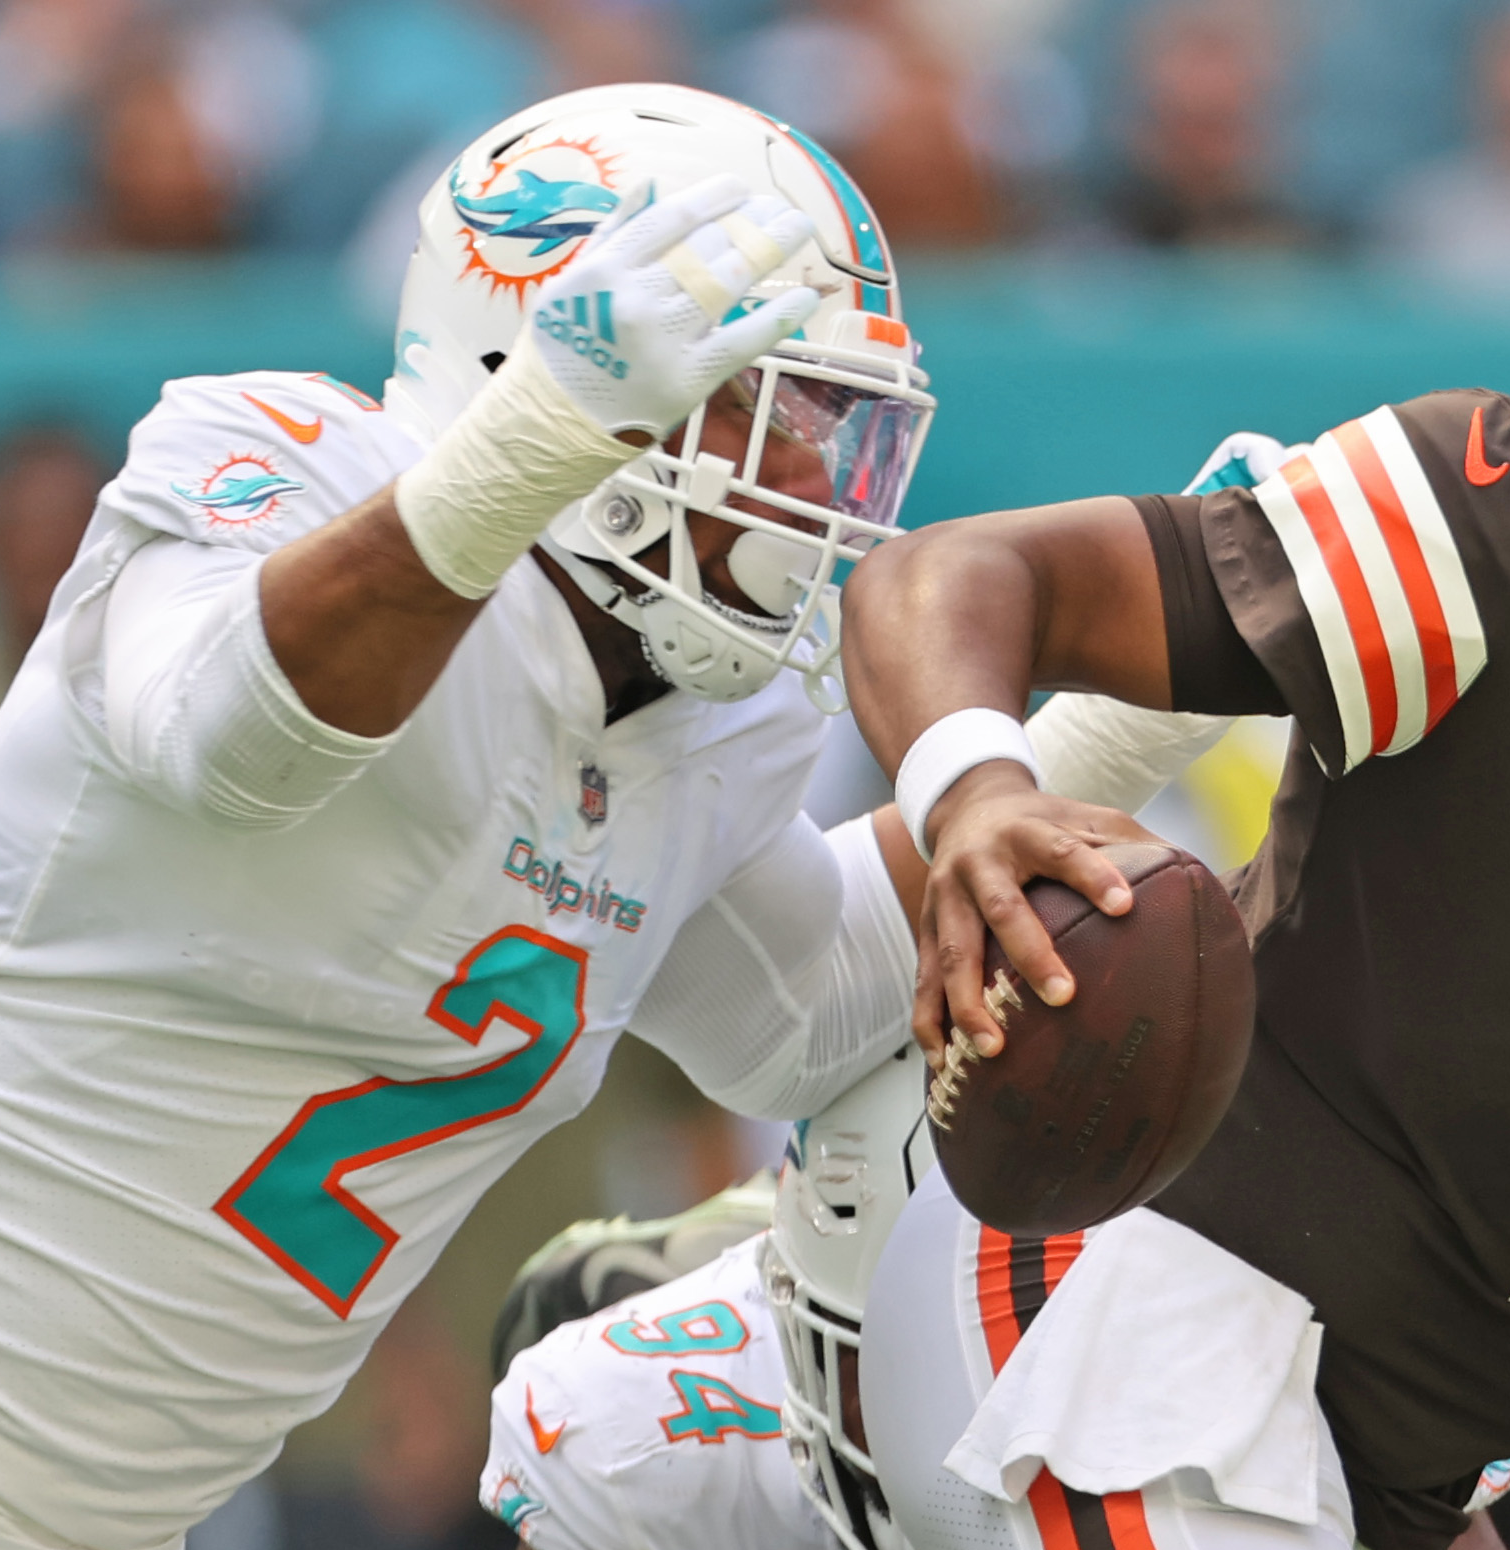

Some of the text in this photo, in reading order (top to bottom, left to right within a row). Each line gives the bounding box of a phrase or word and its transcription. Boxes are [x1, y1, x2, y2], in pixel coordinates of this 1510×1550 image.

[535, 309, 631, 380] adidas
[502, 836, 647, 933] Dolphins
[211, 924, 589, 1321] 2
[601, 1298, 784, 1446] 94
